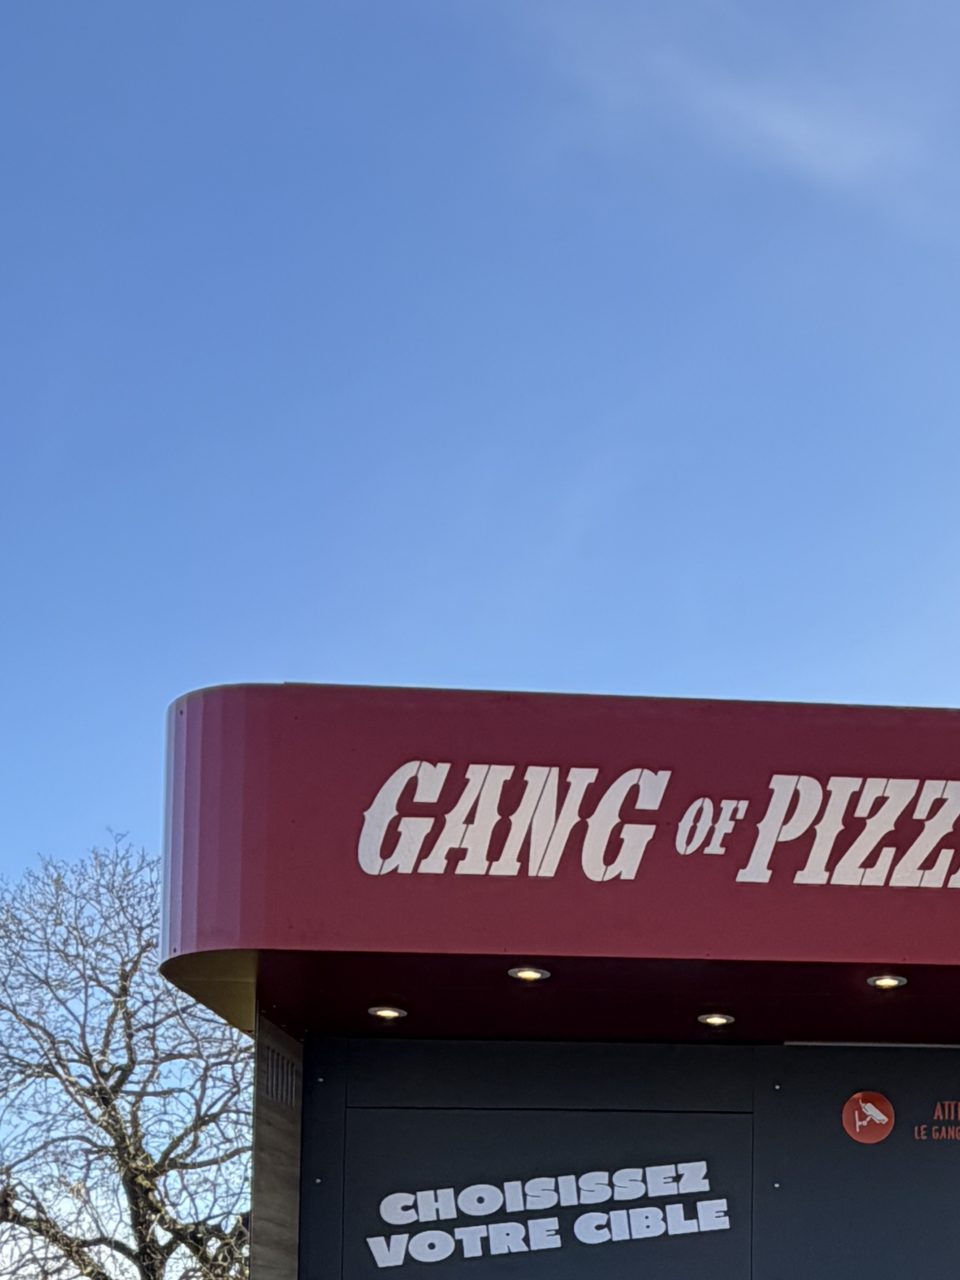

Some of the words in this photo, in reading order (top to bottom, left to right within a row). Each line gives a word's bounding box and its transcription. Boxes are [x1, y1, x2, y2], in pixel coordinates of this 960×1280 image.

[357, 760, 671, 882] GANG
[675, 797, 749, 856] OF
[914, 1125, 928, 1140] LE
[379, 1161, 711, 1225] CHOISISSEZ
[366, 1217, 562, 1268] VOTRE
[573, 1198, 731, 1245] CIBLE
